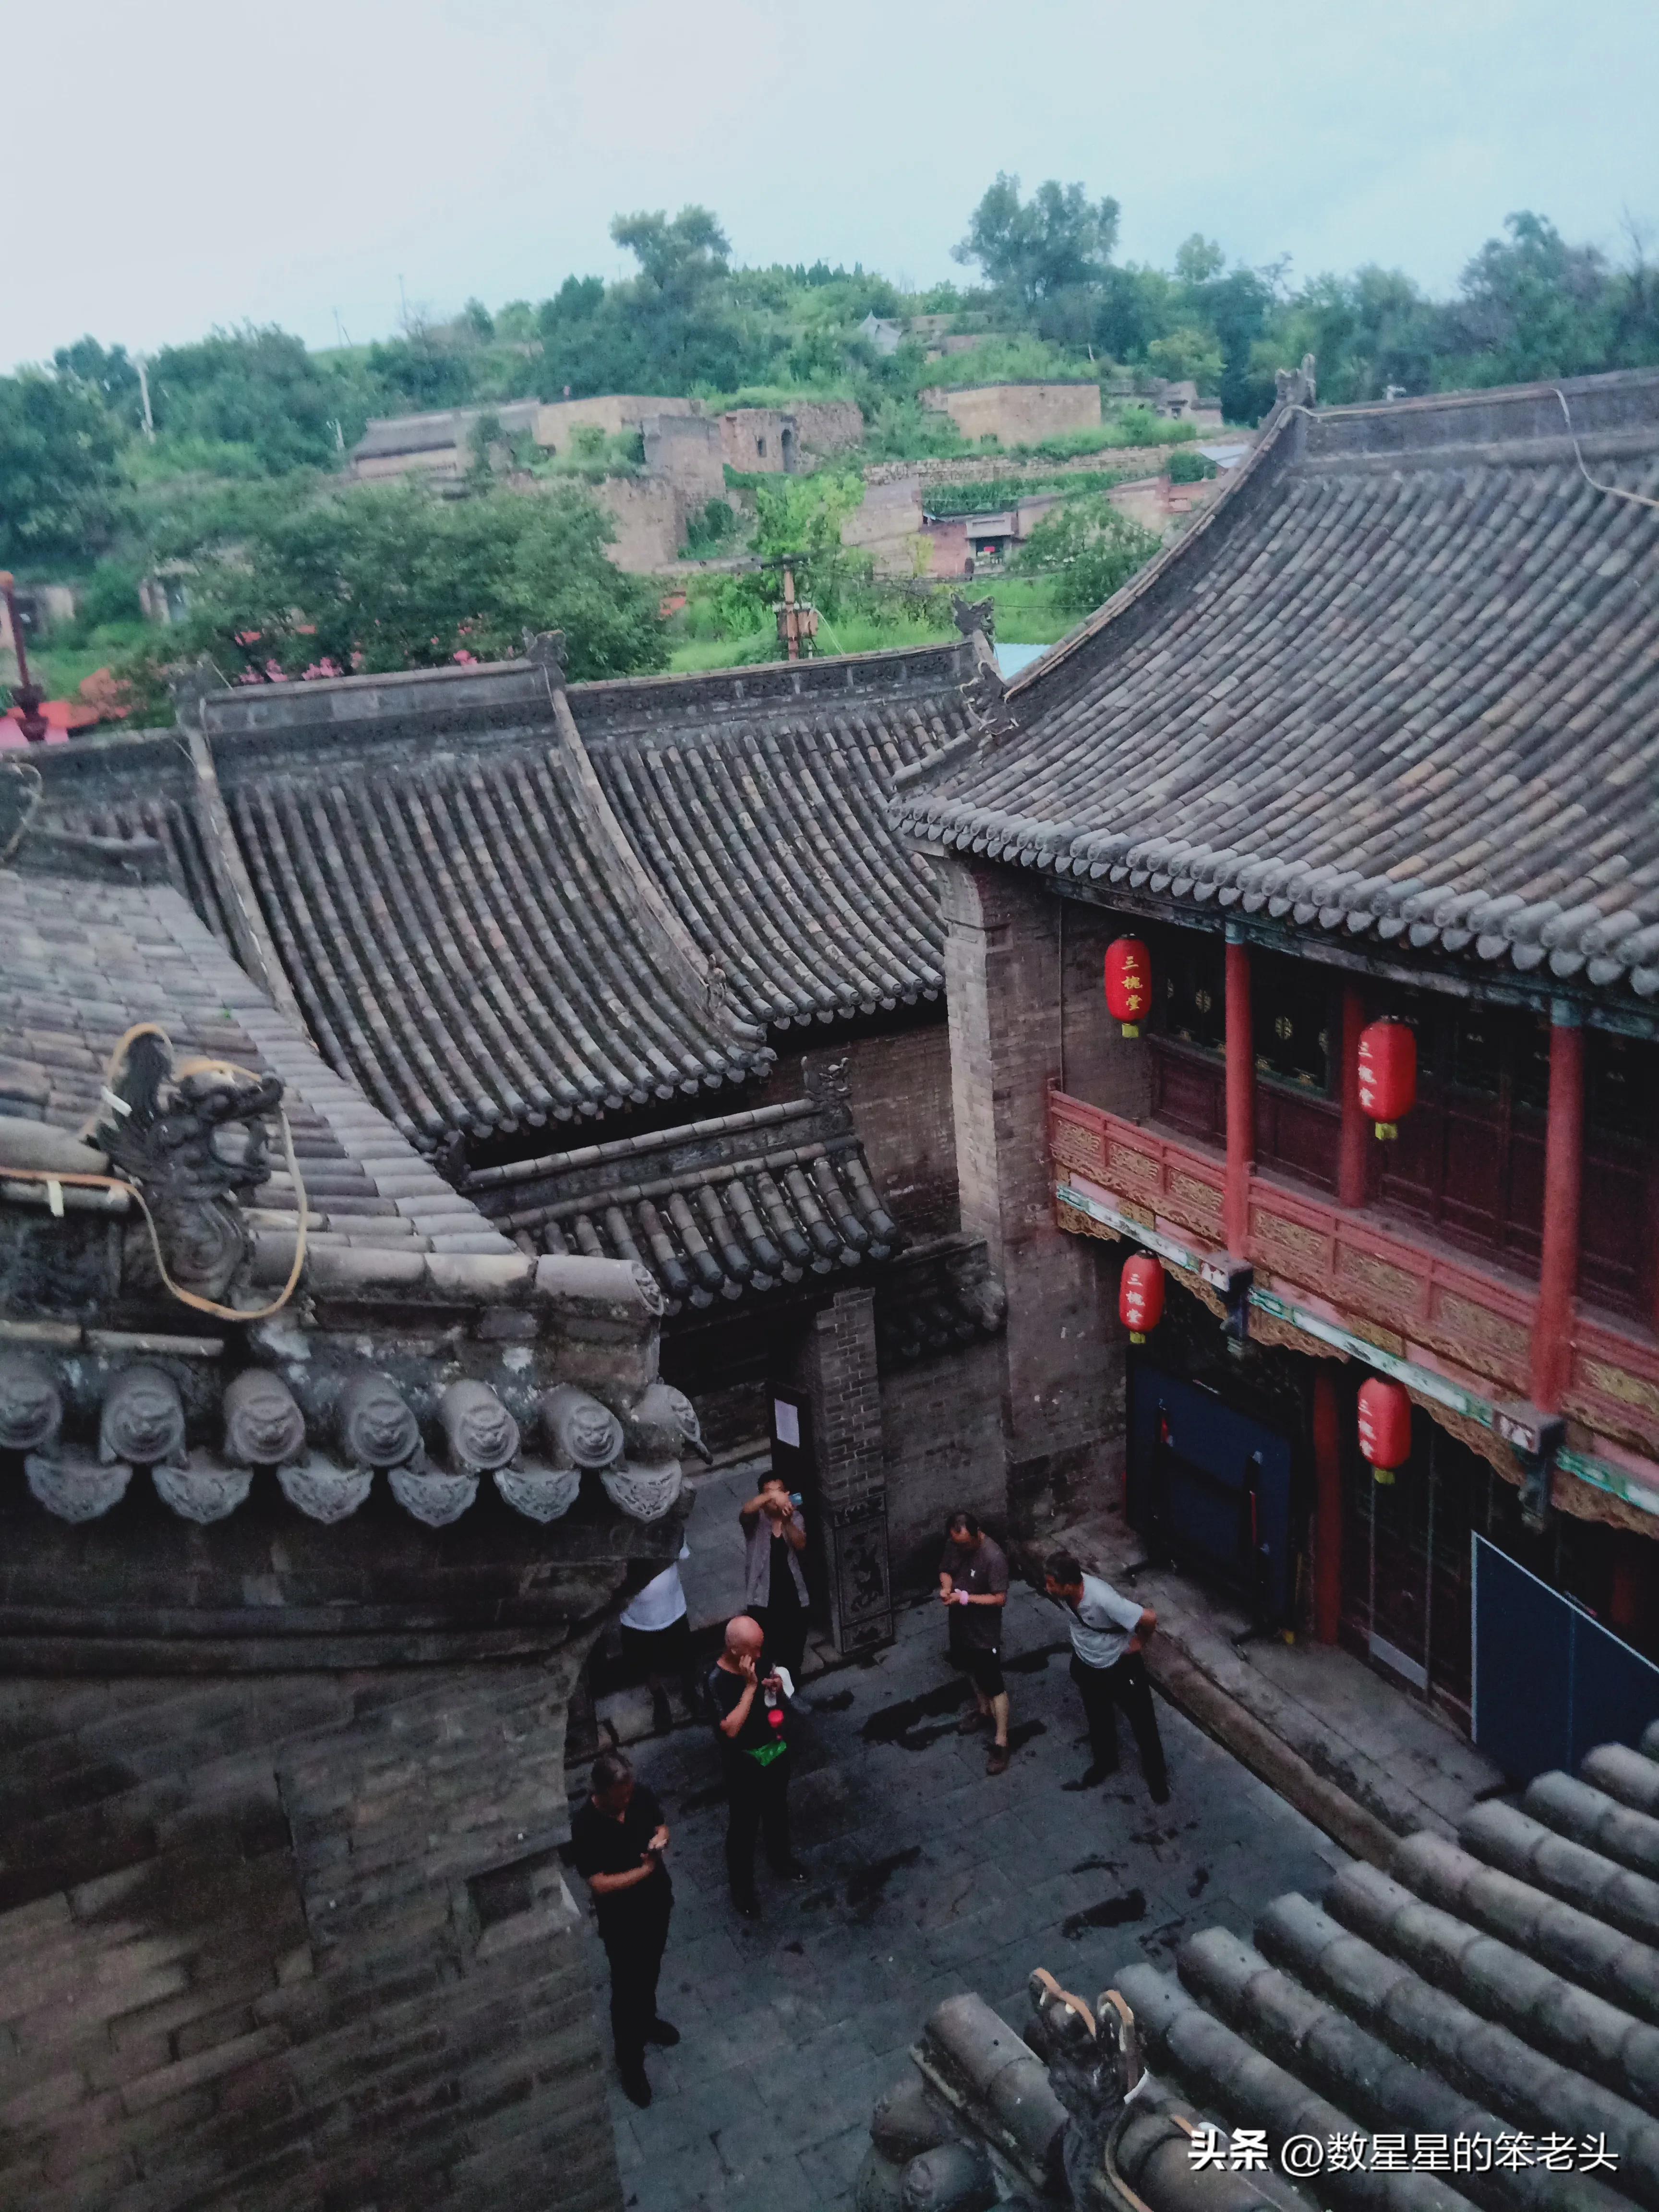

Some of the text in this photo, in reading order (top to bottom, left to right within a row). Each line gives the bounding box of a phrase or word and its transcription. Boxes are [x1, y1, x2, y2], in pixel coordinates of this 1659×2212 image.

[1121, 956, 1143, 1011] 三槐堂
[1126, 1273, 1146, 1325] 三槐堂
